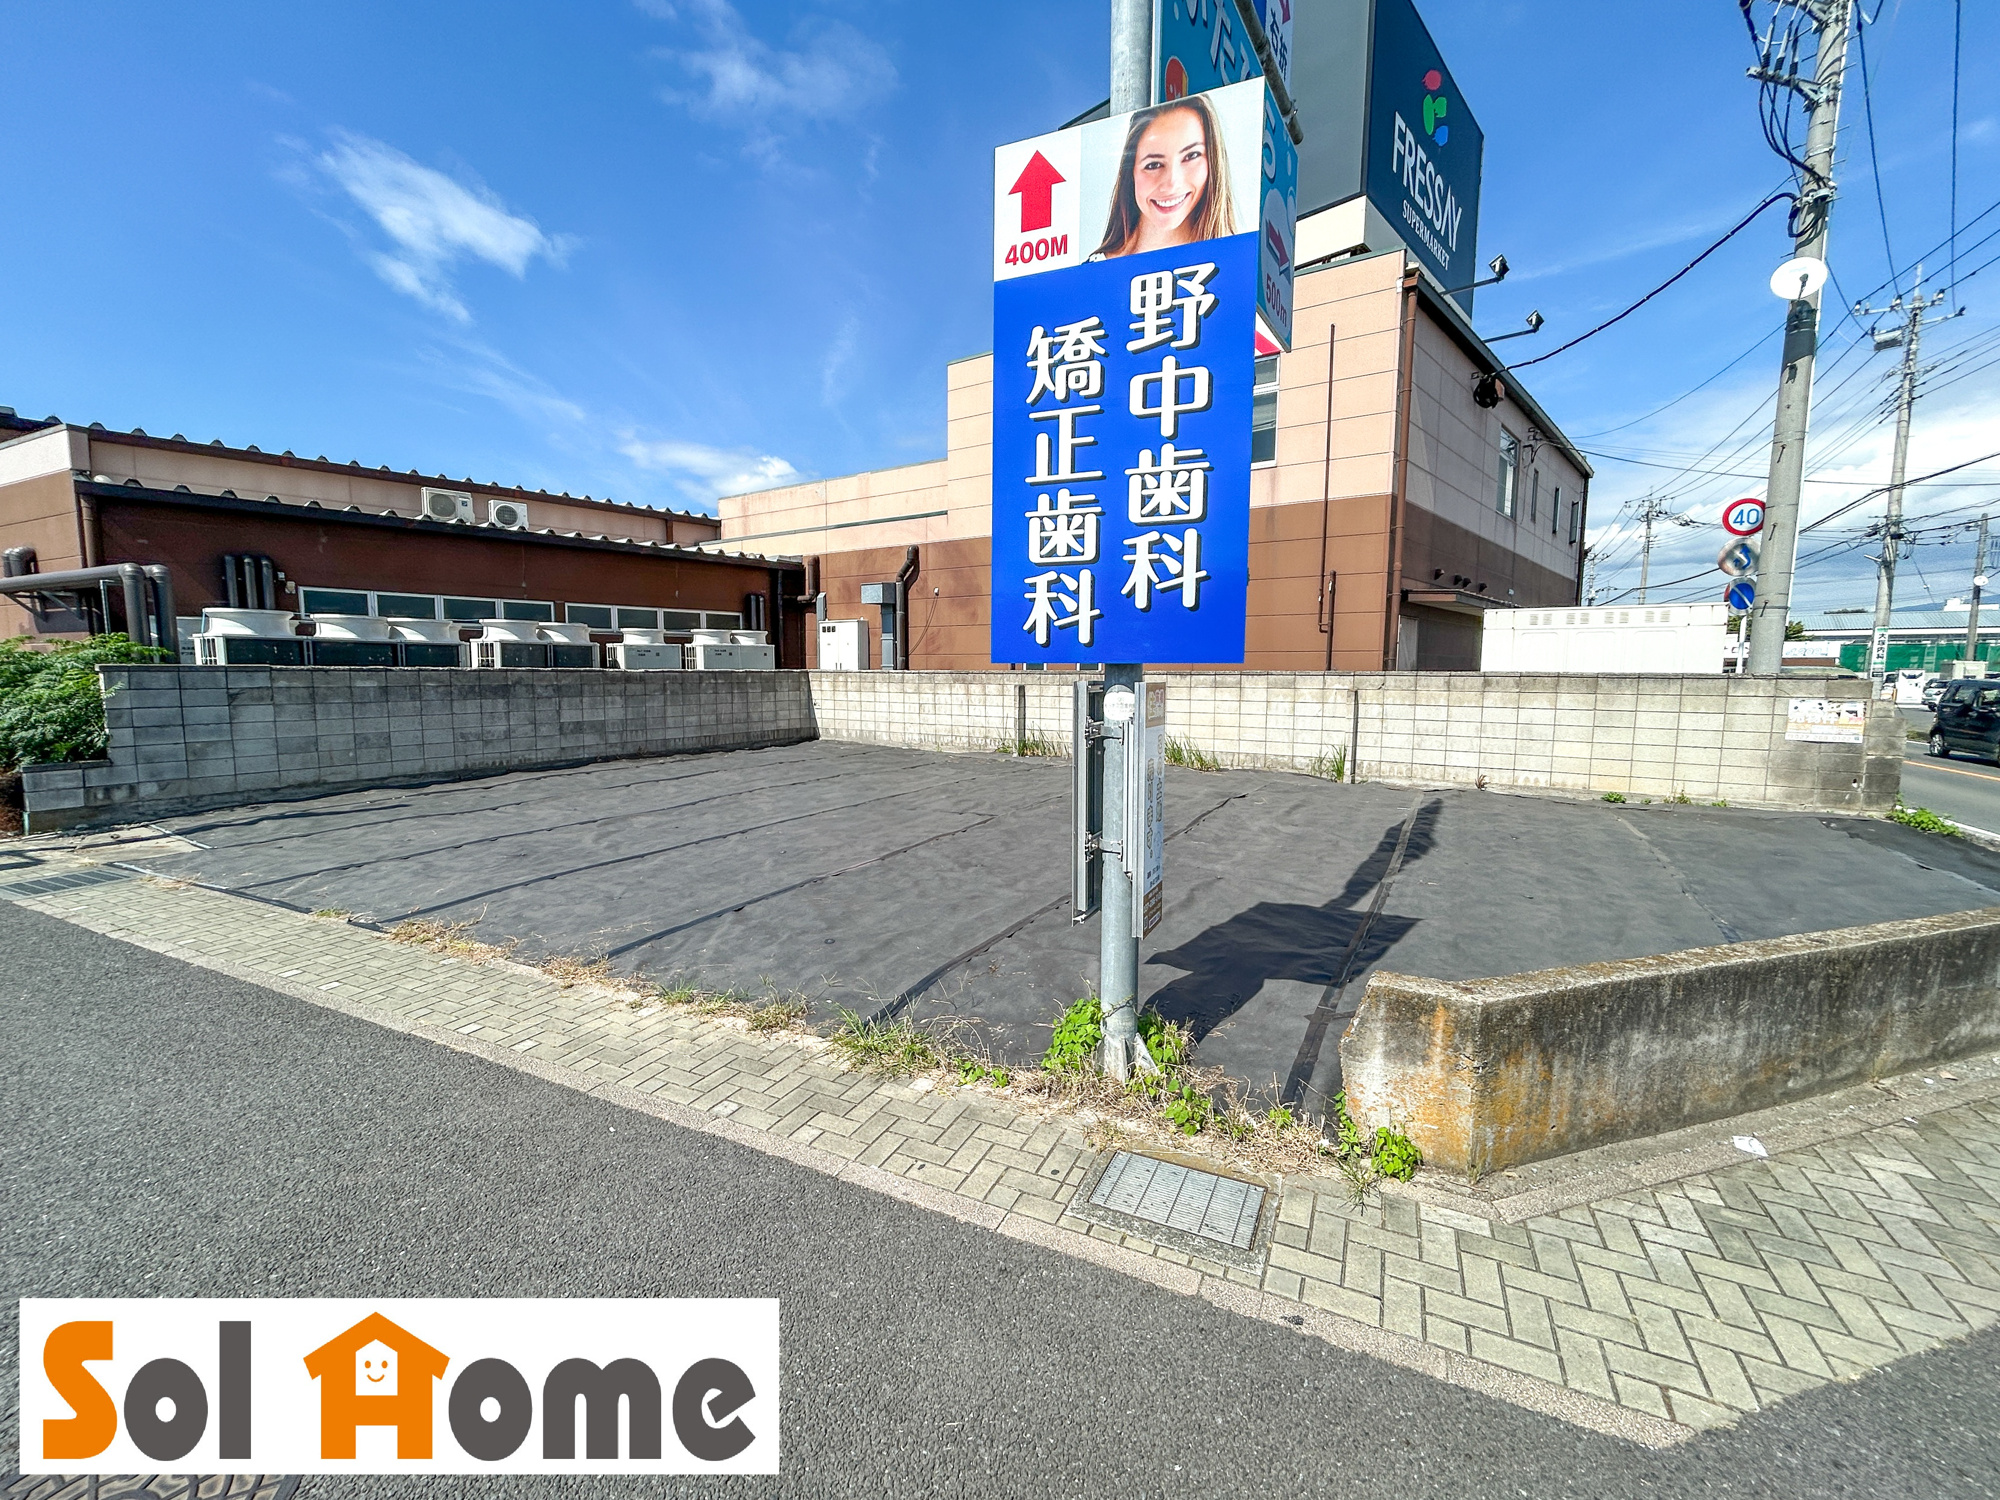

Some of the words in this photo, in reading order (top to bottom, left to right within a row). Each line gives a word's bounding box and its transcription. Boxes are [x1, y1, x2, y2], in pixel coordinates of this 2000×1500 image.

[1392, 110, 1463, 252] FRESSAY
[1005, 234, 1068, 266] 400M
[1402, 199, 1450, 271] SUPERMARKET
[1265, 272, 1288, 328] 500m
[1121, 261, 1219, 610] 野中歯科
[1022, 315, 1107, 647] 矯正歯科
[1733, 508, 1760, 526] 40
